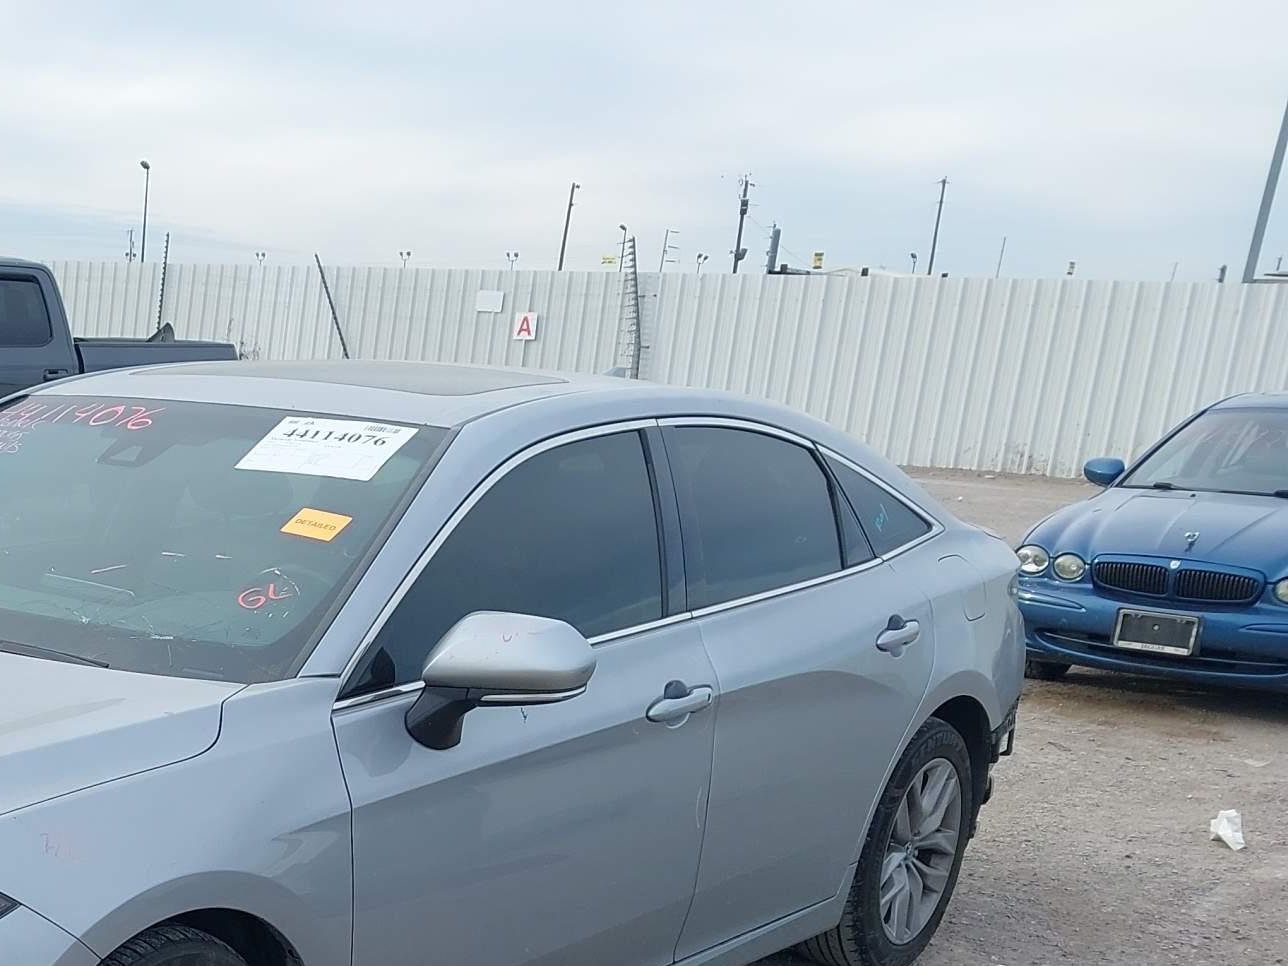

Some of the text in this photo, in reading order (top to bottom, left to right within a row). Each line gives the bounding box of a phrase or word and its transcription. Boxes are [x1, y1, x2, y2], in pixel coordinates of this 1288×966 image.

[516, 316, 532, 336] A
[282, 427, 390, 447] 44114076
[295, 518, 337, 532] DETAILED
